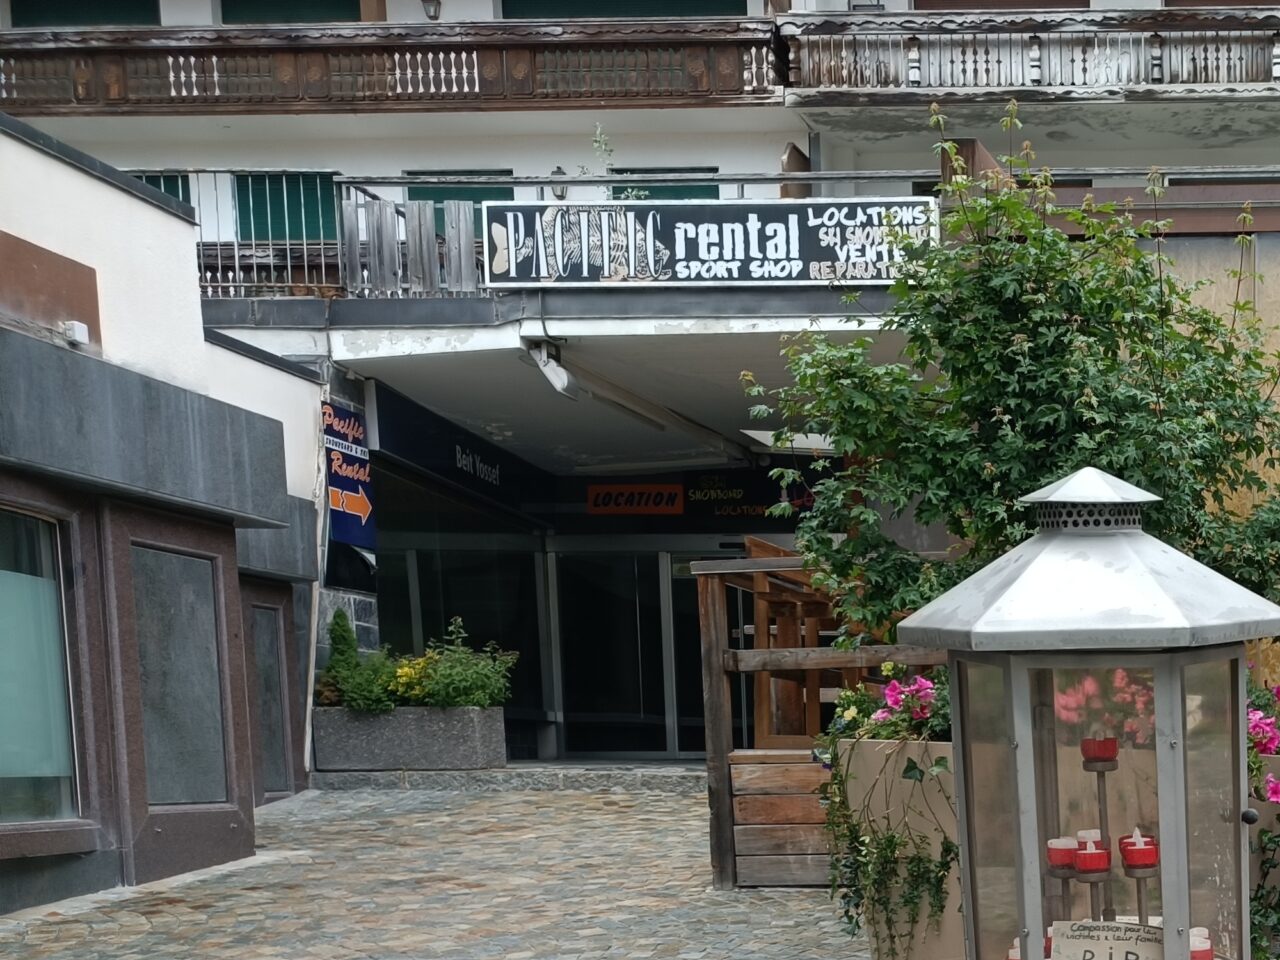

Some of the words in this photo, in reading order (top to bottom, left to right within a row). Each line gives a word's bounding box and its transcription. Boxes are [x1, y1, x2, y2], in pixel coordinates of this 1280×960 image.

[807, 205, 928, 227] LOCATIONS
[505, 209, 664, 279] PACIFIC
[674, 214, 800, 260] rental
[675, 260, 742, 279] SPORT
[750, 259, 803, 280] SHOP
[322, 404, 364, 443] Pacific
[330, 450, 371, 483] Rental
[456, 444, 474, 475] Beit
[474, 454, 500, 486] Yossef
[592, 491, 678, 508] LOCATION
